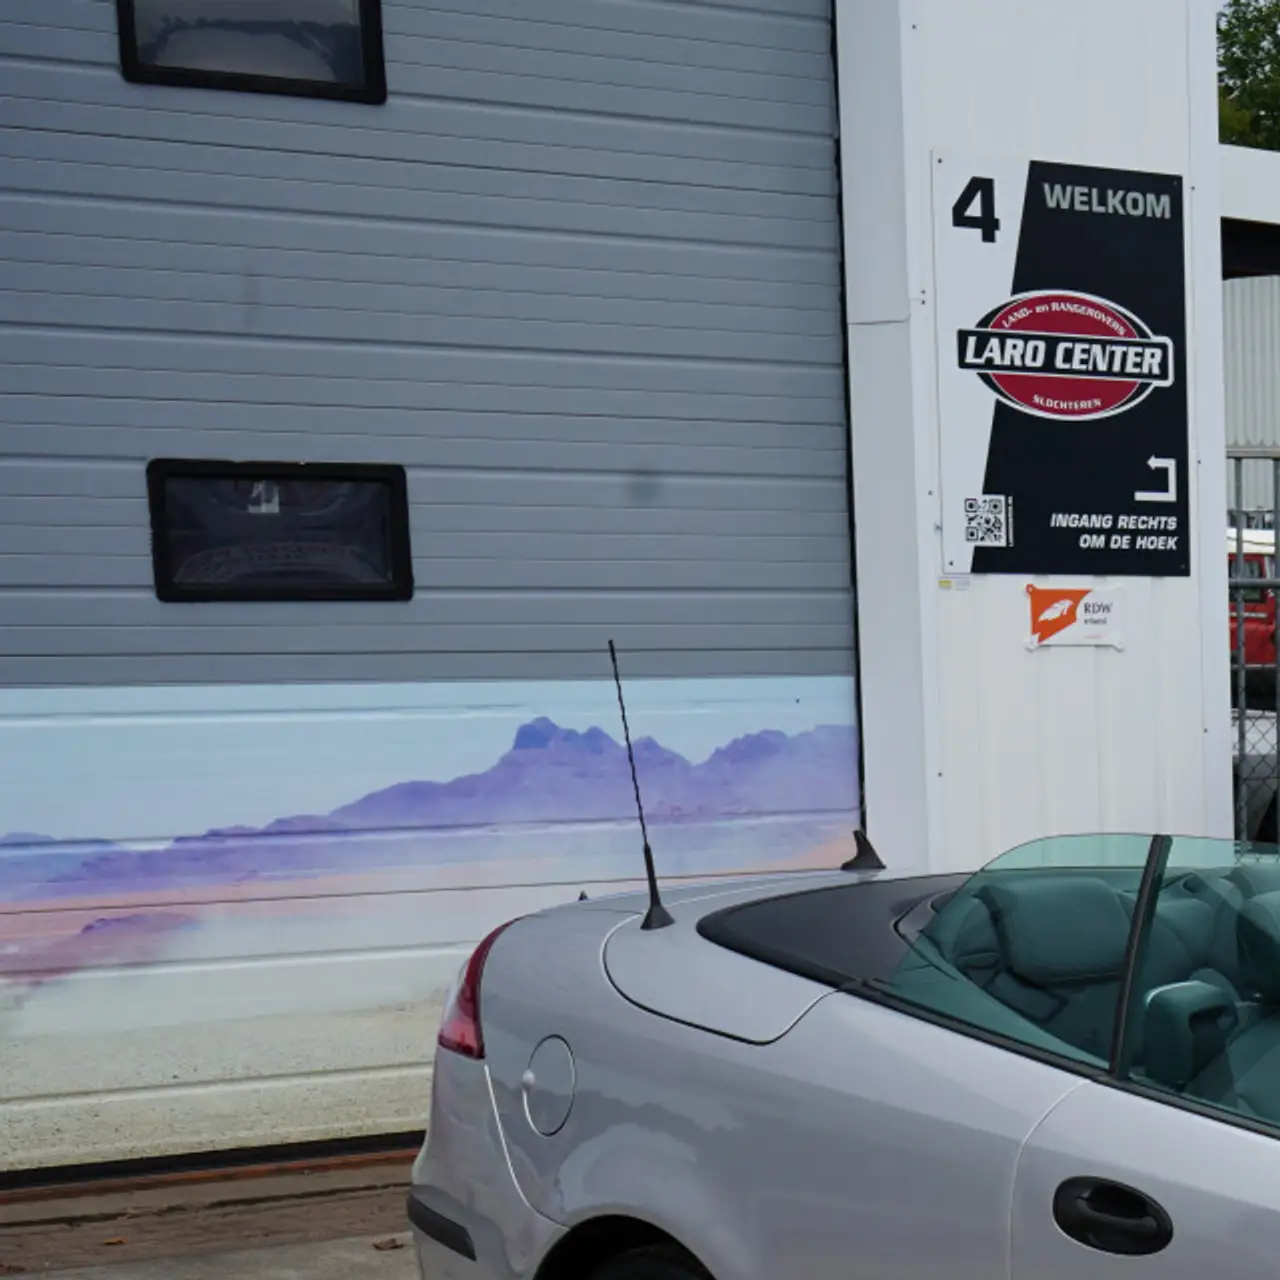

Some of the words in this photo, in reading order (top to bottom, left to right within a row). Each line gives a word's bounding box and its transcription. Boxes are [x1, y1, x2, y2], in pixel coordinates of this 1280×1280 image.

[951, 175, 1000, 243] 4
[1043, 182, 1171, 219] WELKOM
[1036, 305, 1050, 314] en
[1051, 301, 1126, 337] RANGEROVERS
[964, 334, 1046, 368] LARO
[1055, 341, 1163, 376] CENTER
[1032, 394, 1102, 410] SLOCHTEREN
[1050, 513, 1113, 529] INGANG
[1118, 514, 1178, 531] RECHTS
[1079, 534, 1106, 549] OM
[1110, 534, 1132, 549] DE
[1136, 535, 1178, 551] HOEK
